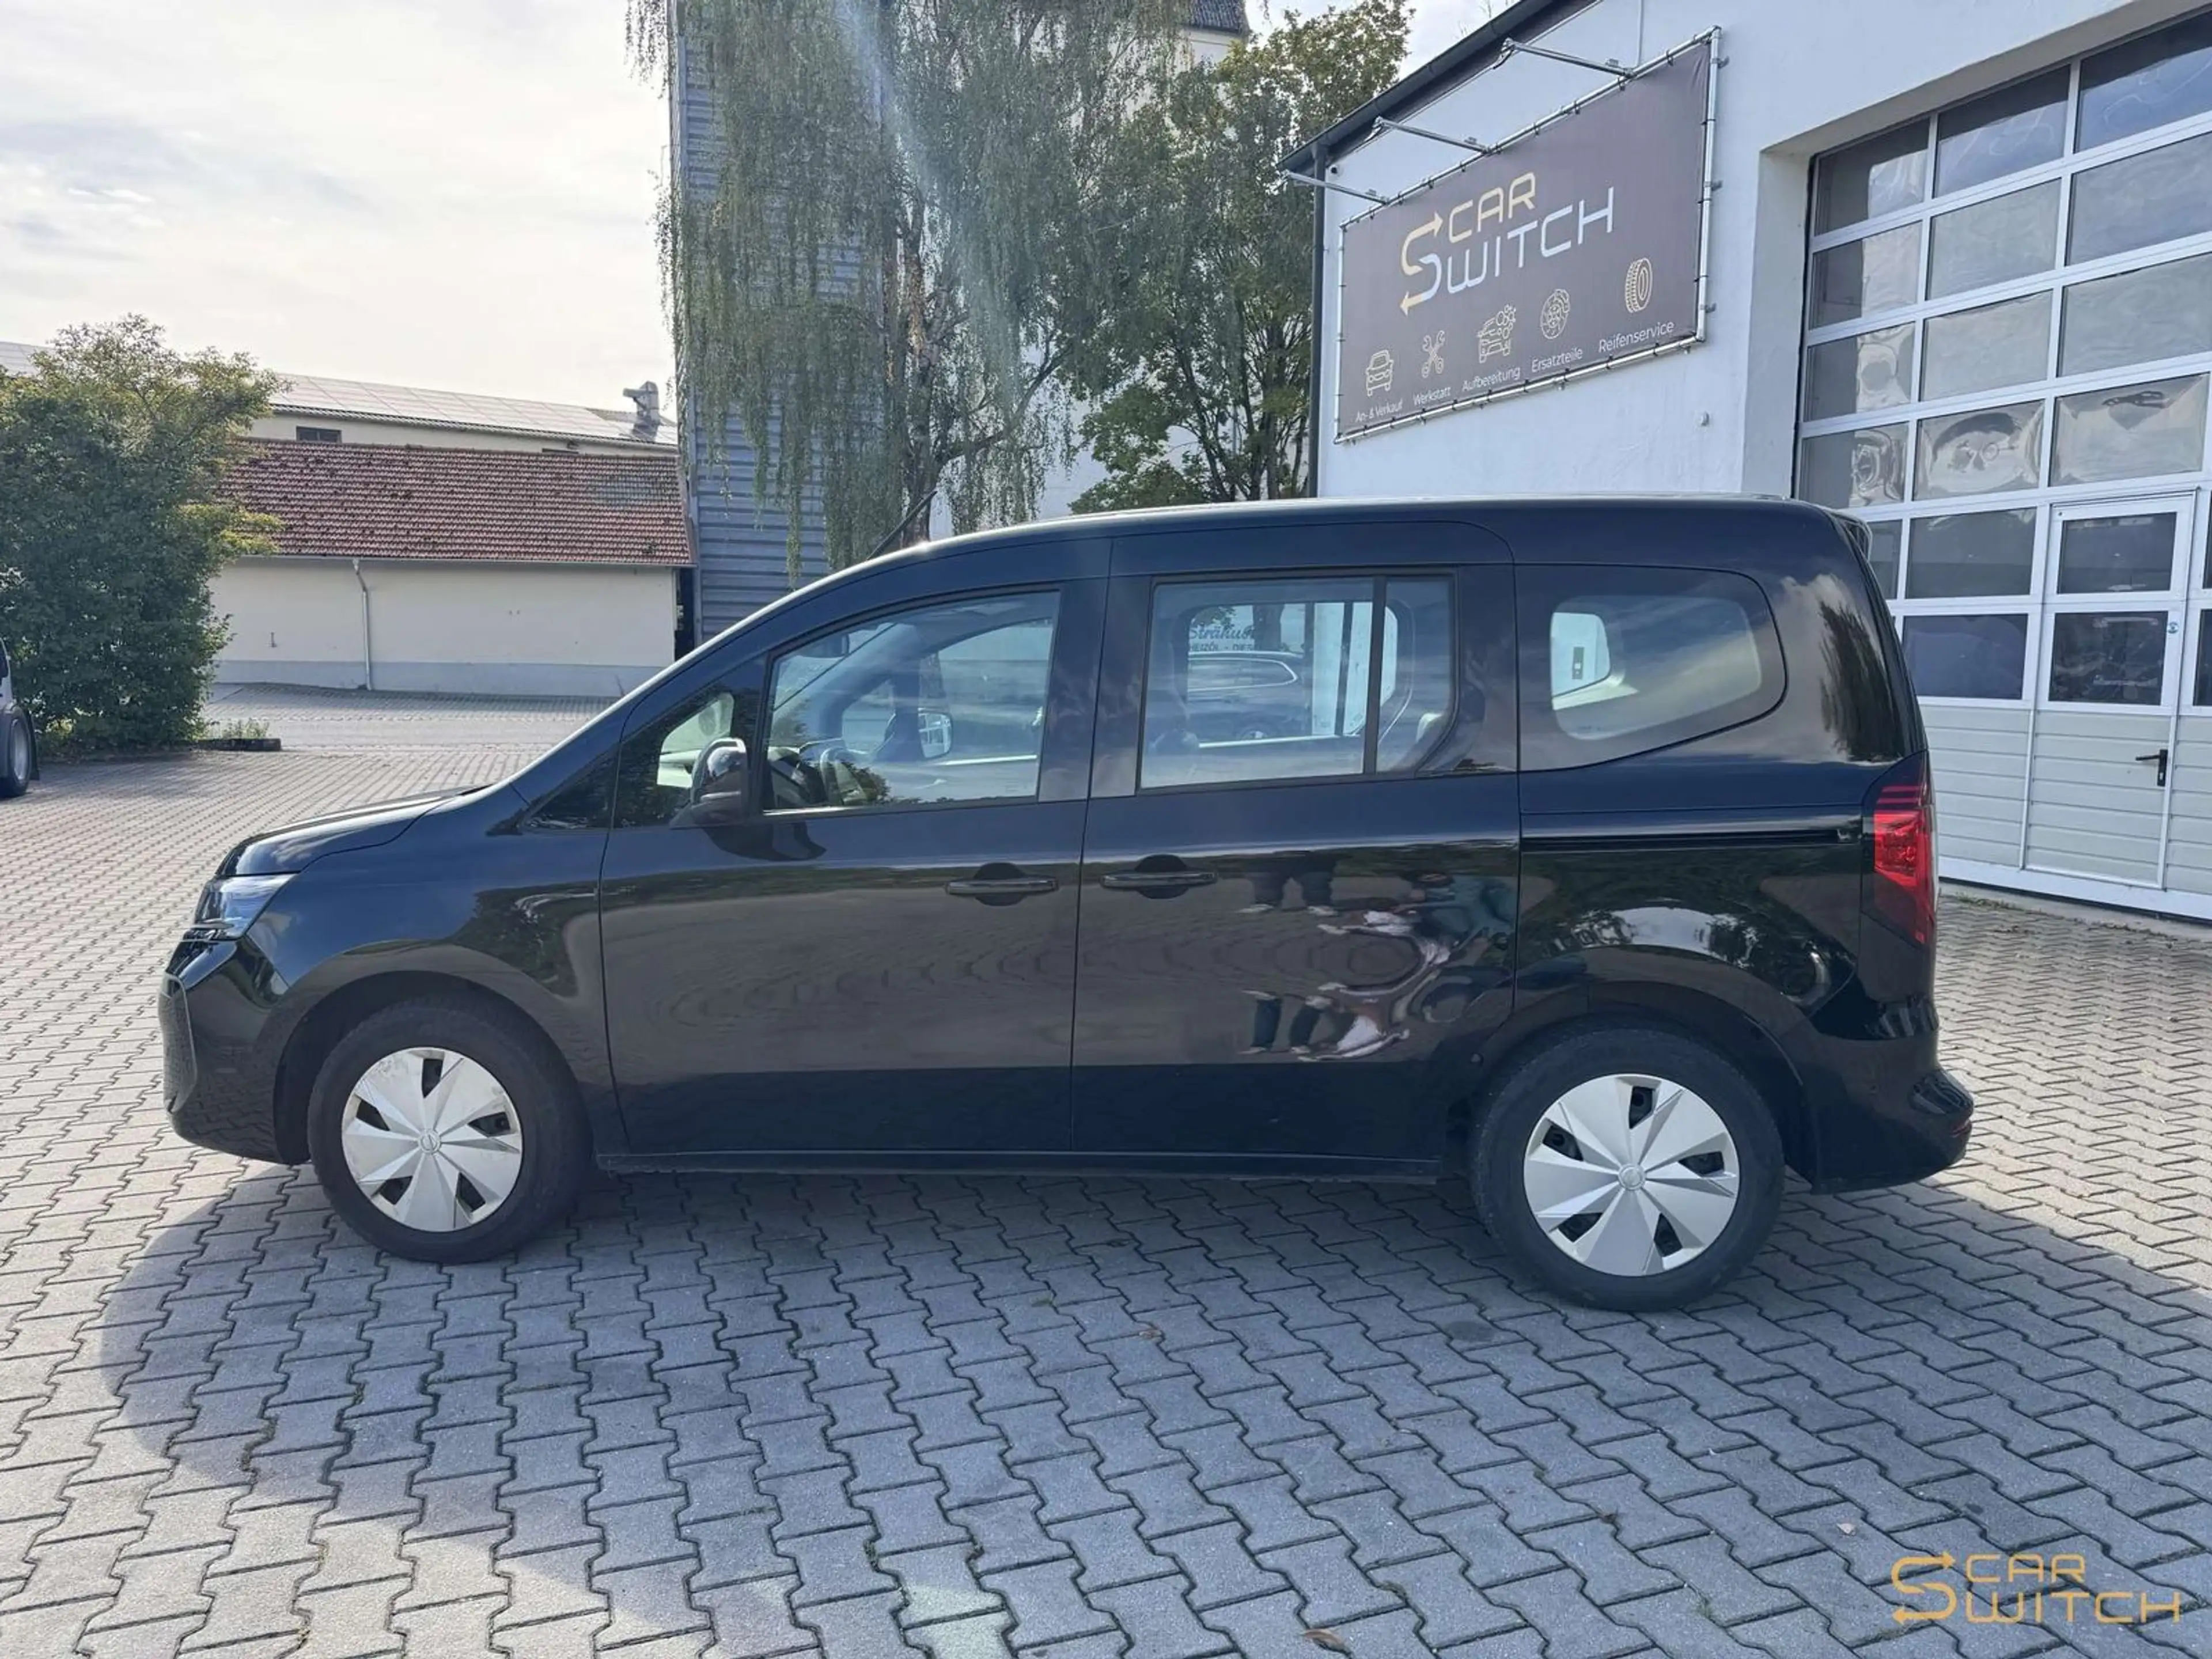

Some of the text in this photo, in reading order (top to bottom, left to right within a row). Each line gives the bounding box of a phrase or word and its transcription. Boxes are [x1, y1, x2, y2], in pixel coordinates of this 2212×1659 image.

[1448, 172, 1536, 244] CAR
[1598, 321, 1675, 353] Reifenservice
[1531, 346, 1584, 373] Ersatzteile
[1461, 366, 1521, 392] Aufbereitung
[1376, 397, 1403, 418] Verkauf
[1413, 387, 1452, 406] Werkstatt
